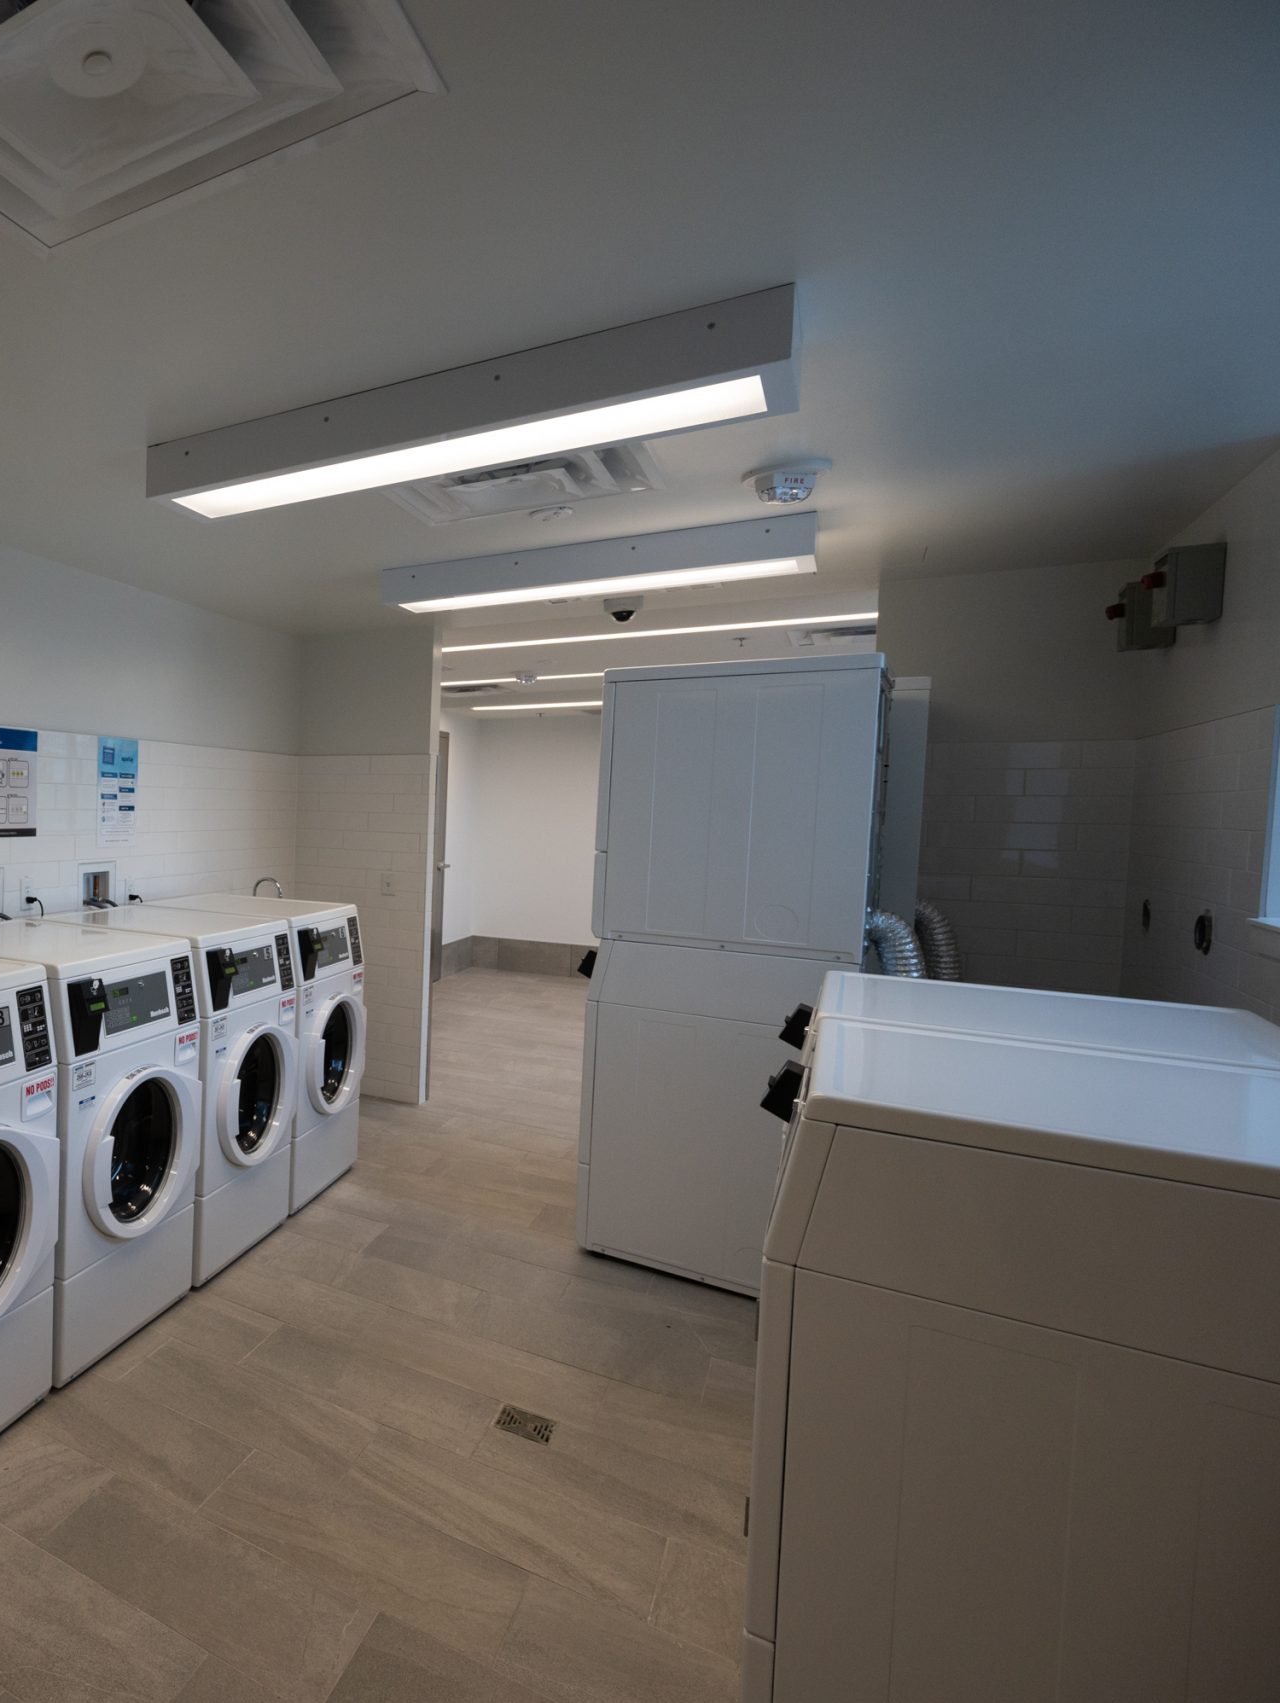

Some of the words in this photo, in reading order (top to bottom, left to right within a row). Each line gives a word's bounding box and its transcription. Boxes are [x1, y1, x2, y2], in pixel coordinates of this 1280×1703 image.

[265, 947, 270, 959] 5
[178, 1035, 185, 1045] NO
[26, 1085, 34, 1096] NO
[36, 1077, 54, 1092] PODS!!
